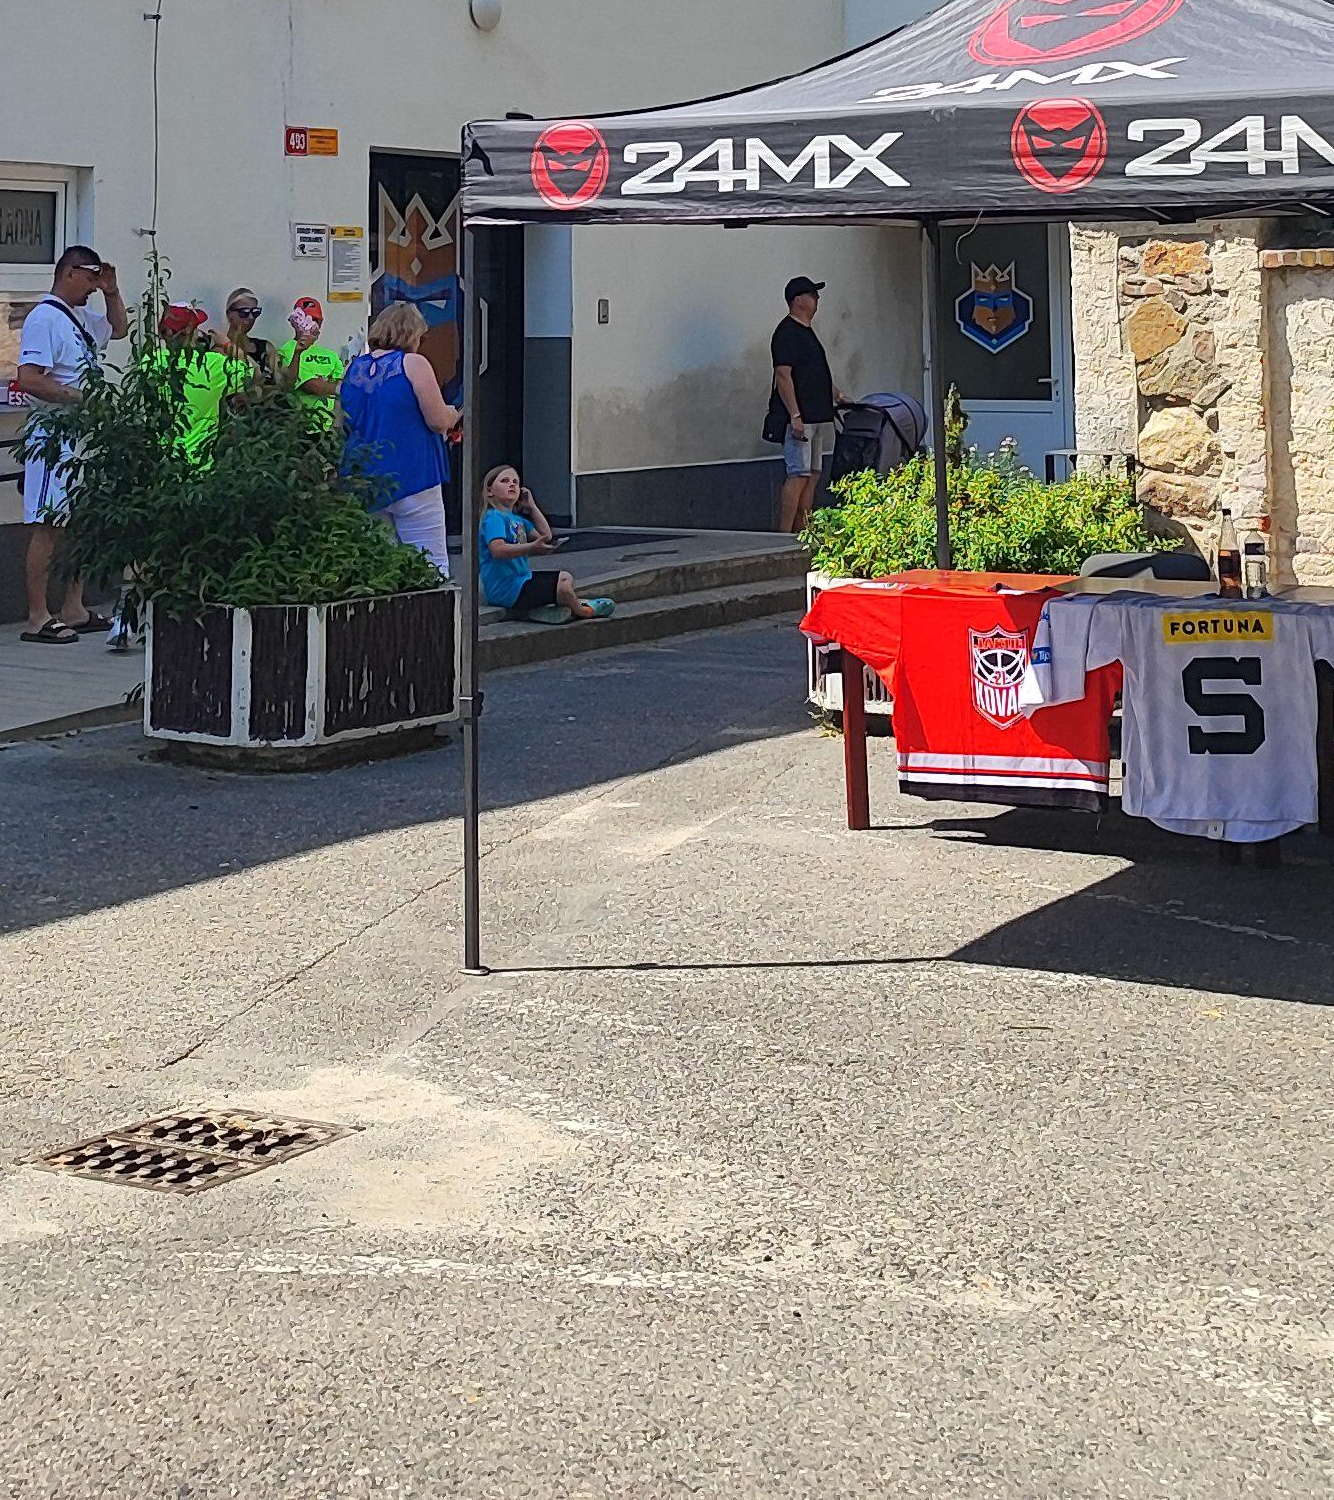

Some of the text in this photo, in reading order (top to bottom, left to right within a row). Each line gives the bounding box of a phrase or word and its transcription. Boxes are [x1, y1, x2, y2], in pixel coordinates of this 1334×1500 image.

[856, 57, 1189, 104] 24MX
[620, 130, 912, 197] 24MX
[1170, 618, 1265, 637] FORTUNA
[1181, 656, 1267, 755] S
